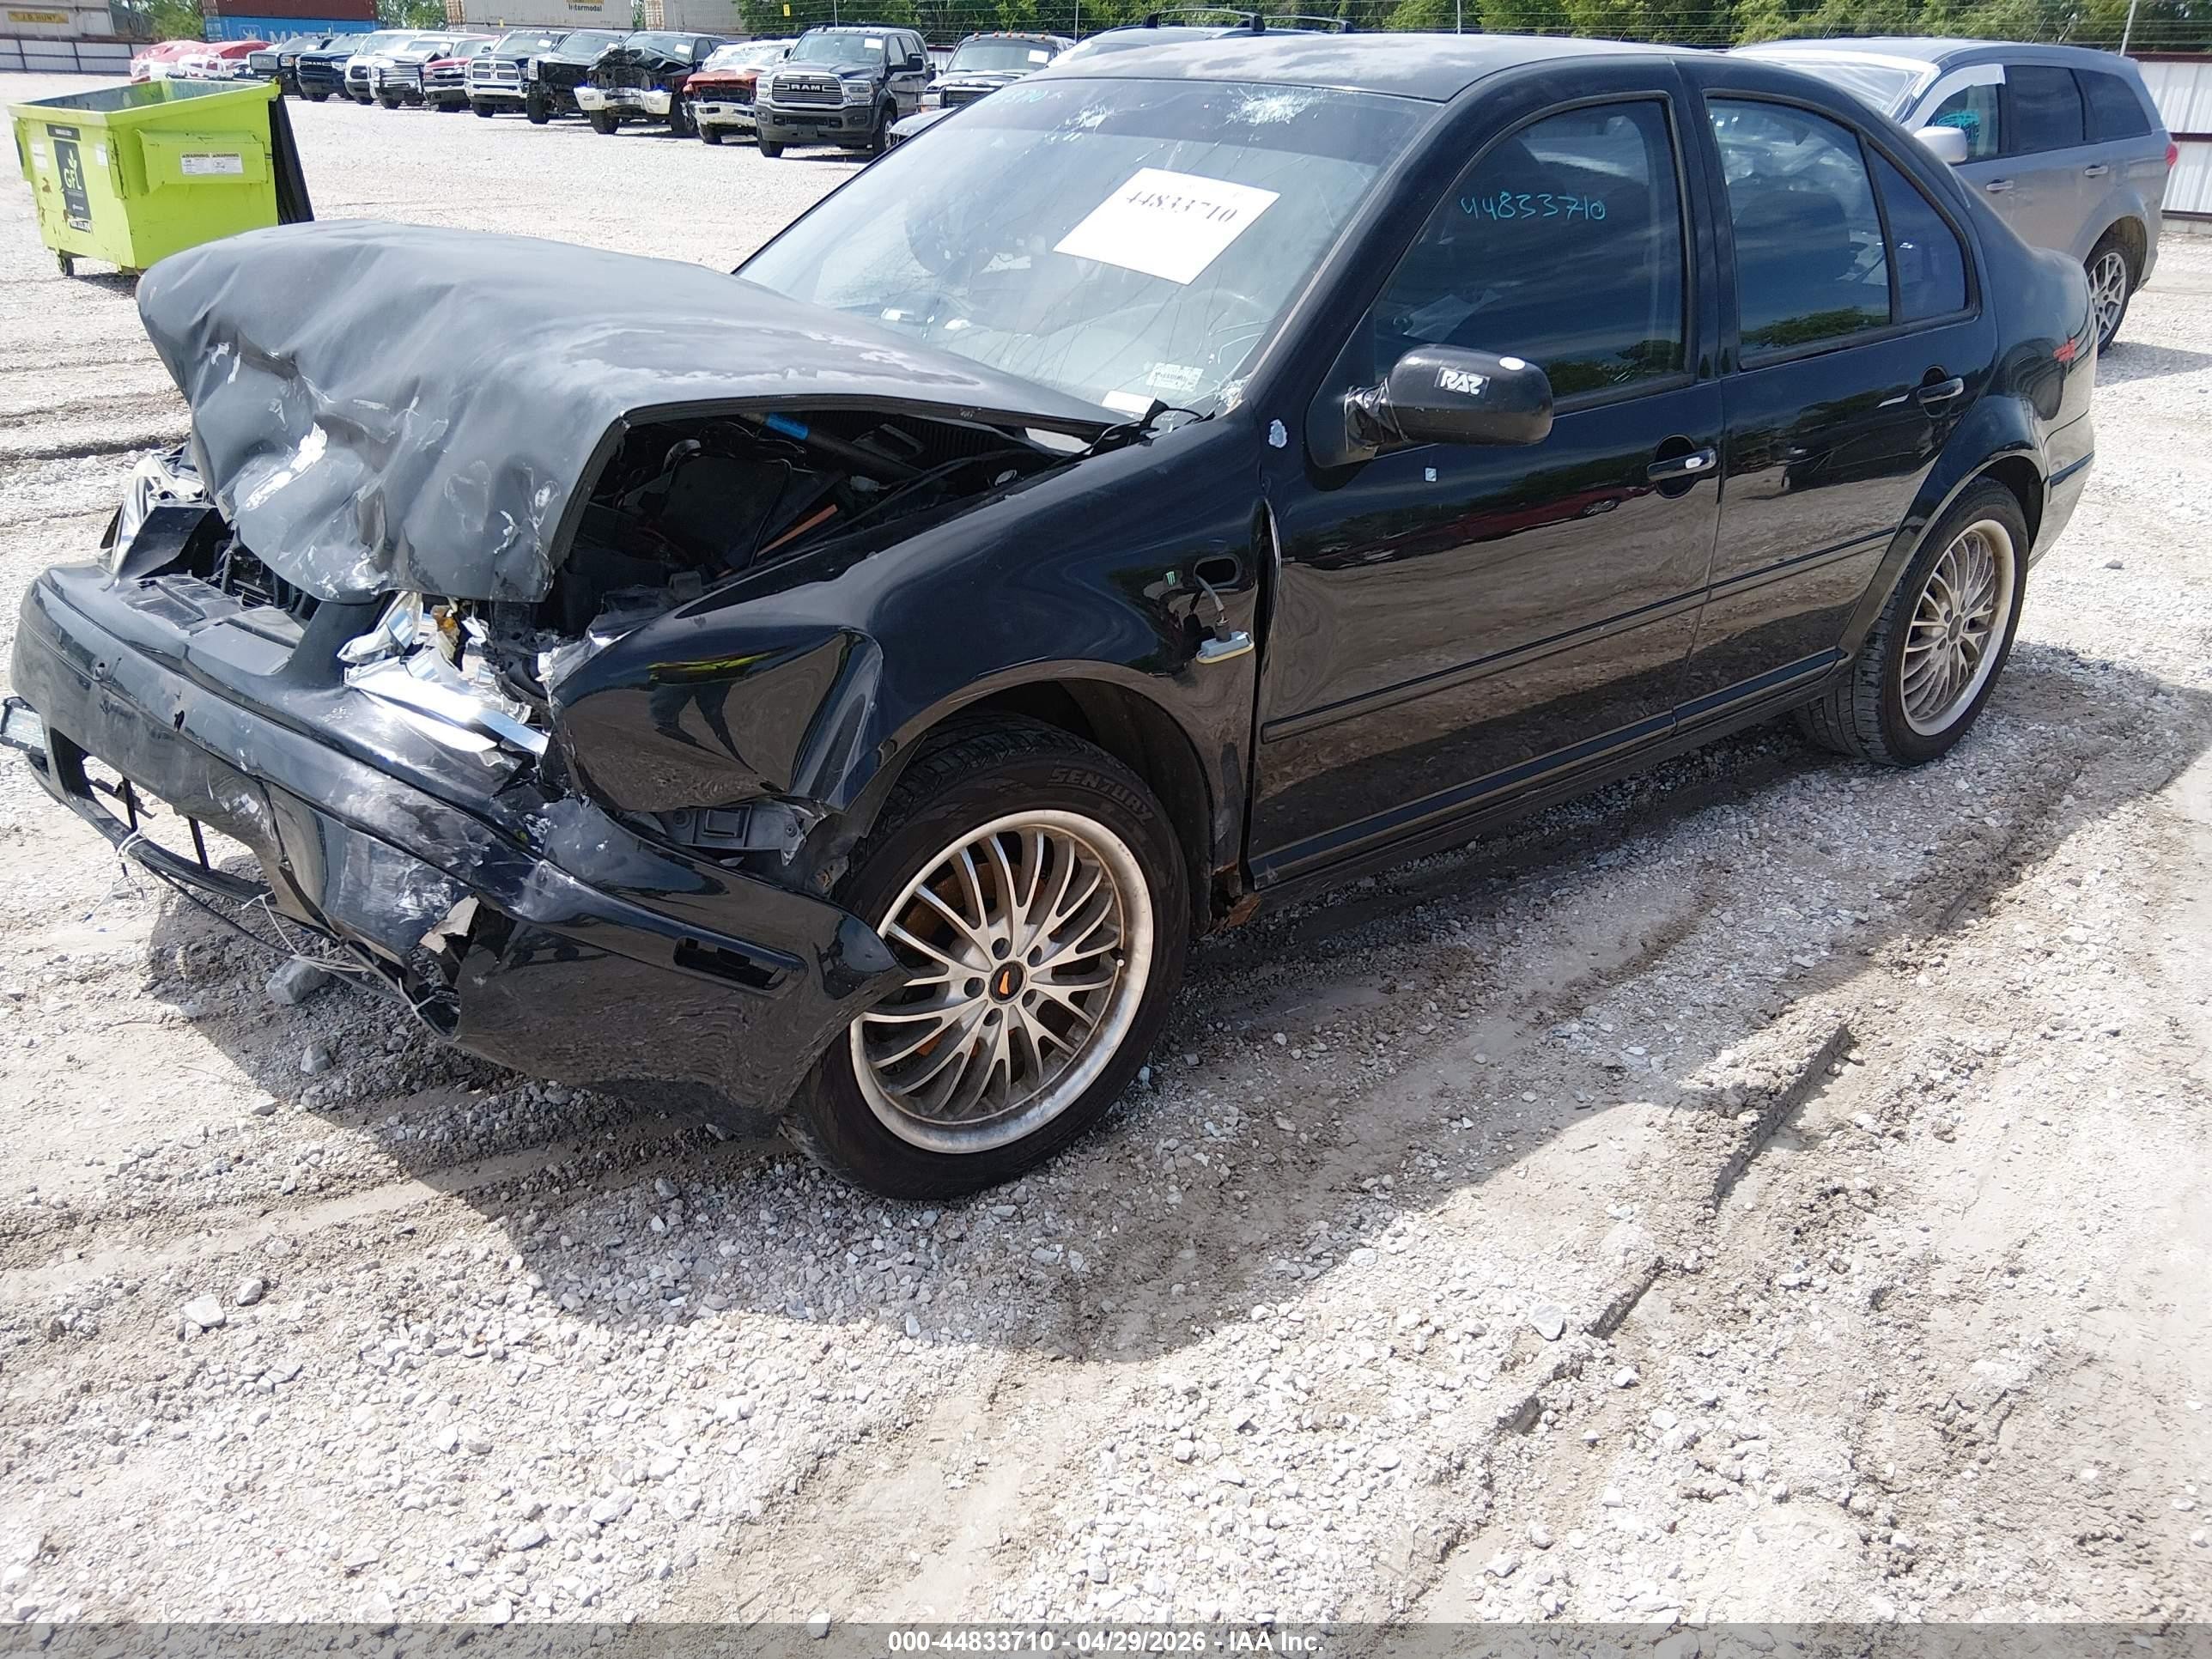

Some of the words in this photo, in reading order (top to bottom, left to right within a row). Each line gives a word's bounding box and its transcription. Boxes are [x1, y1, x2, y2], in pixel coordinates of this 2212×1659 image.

[64, 166, 82, 191] GFL
[1126, 191, 1237, 222] 44833710
[1460, 191, 1606, 221] 44833710
[1440, 370, 1484, 395] RAZ
